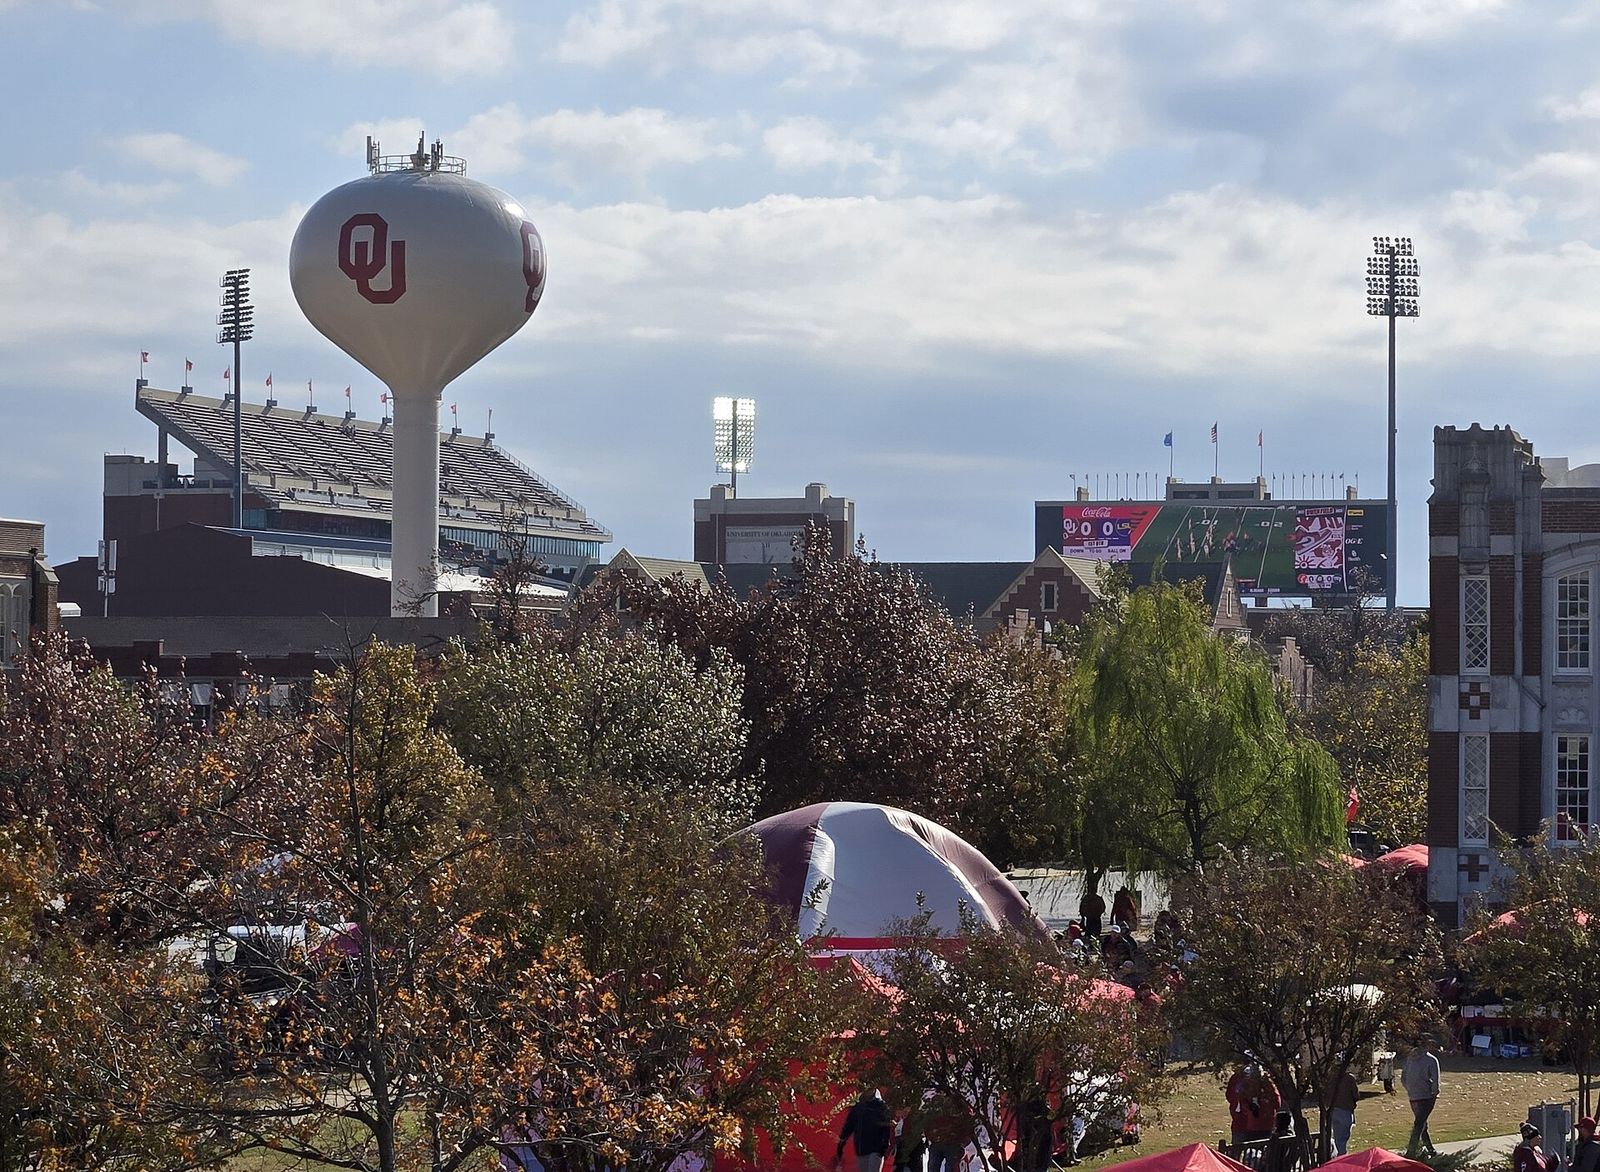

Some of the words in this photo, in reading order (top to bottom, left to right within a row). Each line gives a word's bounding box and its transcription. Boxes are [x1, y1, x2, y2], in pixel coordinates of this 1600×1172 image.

[338, 212, 407, 304] OU
[1082, 506, 1112, 518] Coca-Cola
[1081, 522, 1091, 536] 0
[1103, 522, 1113, 536] 0
